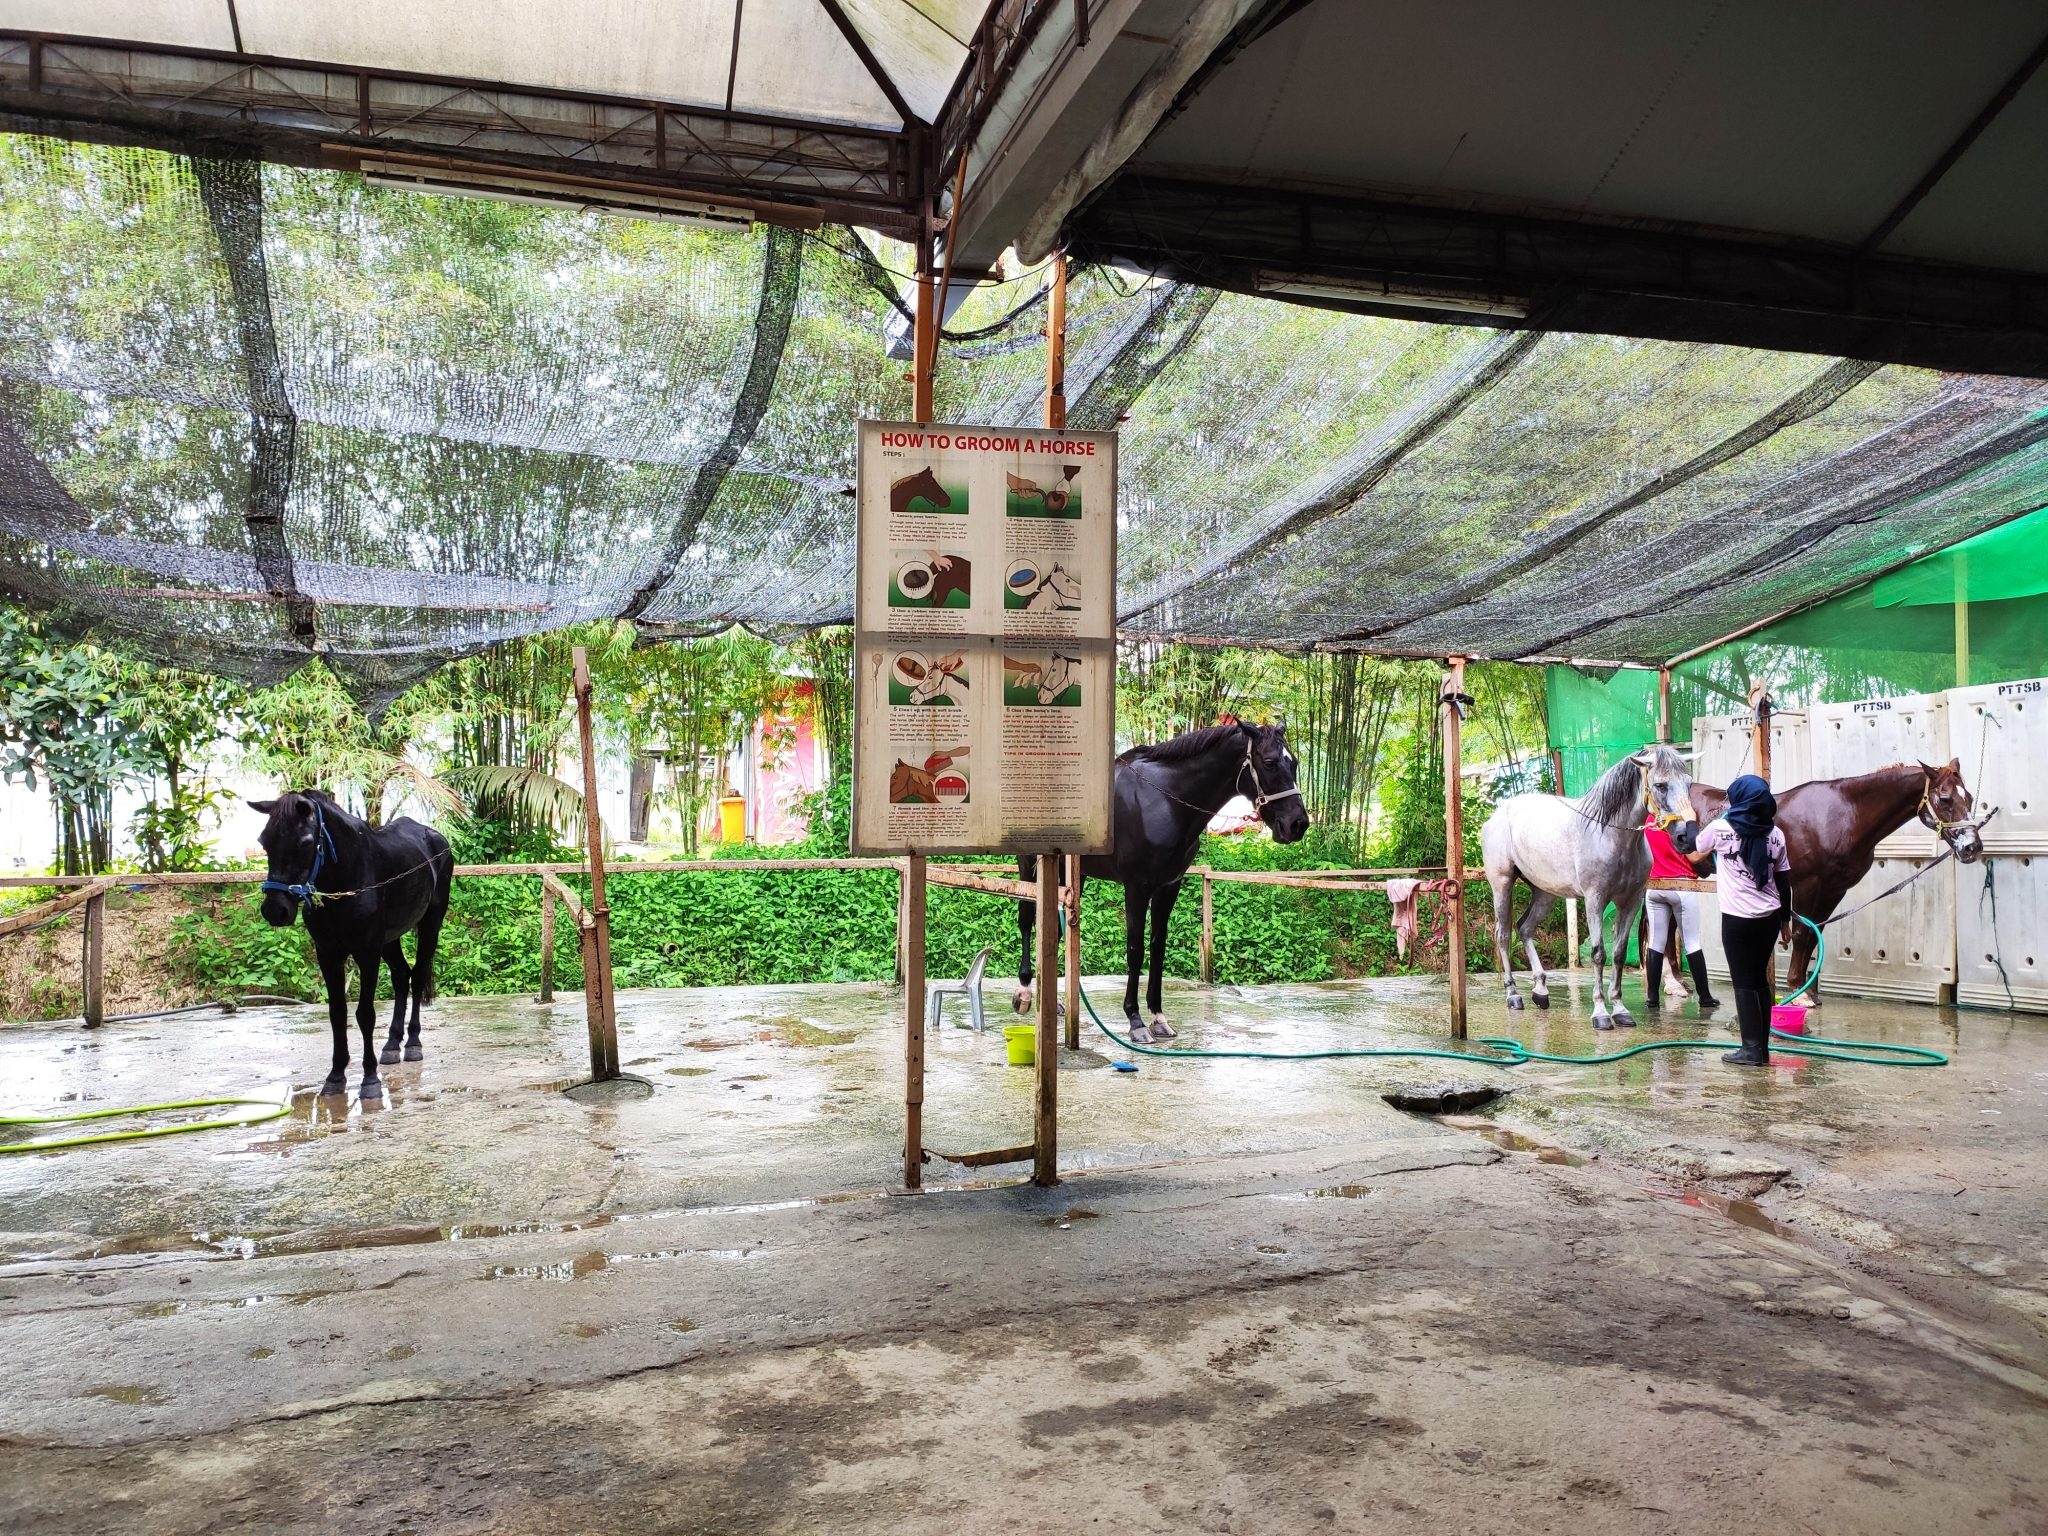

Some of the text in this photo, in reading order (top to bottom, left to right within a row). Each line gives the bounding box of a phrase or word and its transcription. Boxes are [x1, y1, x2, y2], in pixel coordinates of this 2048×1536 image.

[881, 432, 1095, 456] HOW TO GROOM A HORSE
[1998, 681, 2041, 696] PTTSB
[1854, 701, 1892, 713] PTTSB
[1720, 831, 1740, 842] Let's
